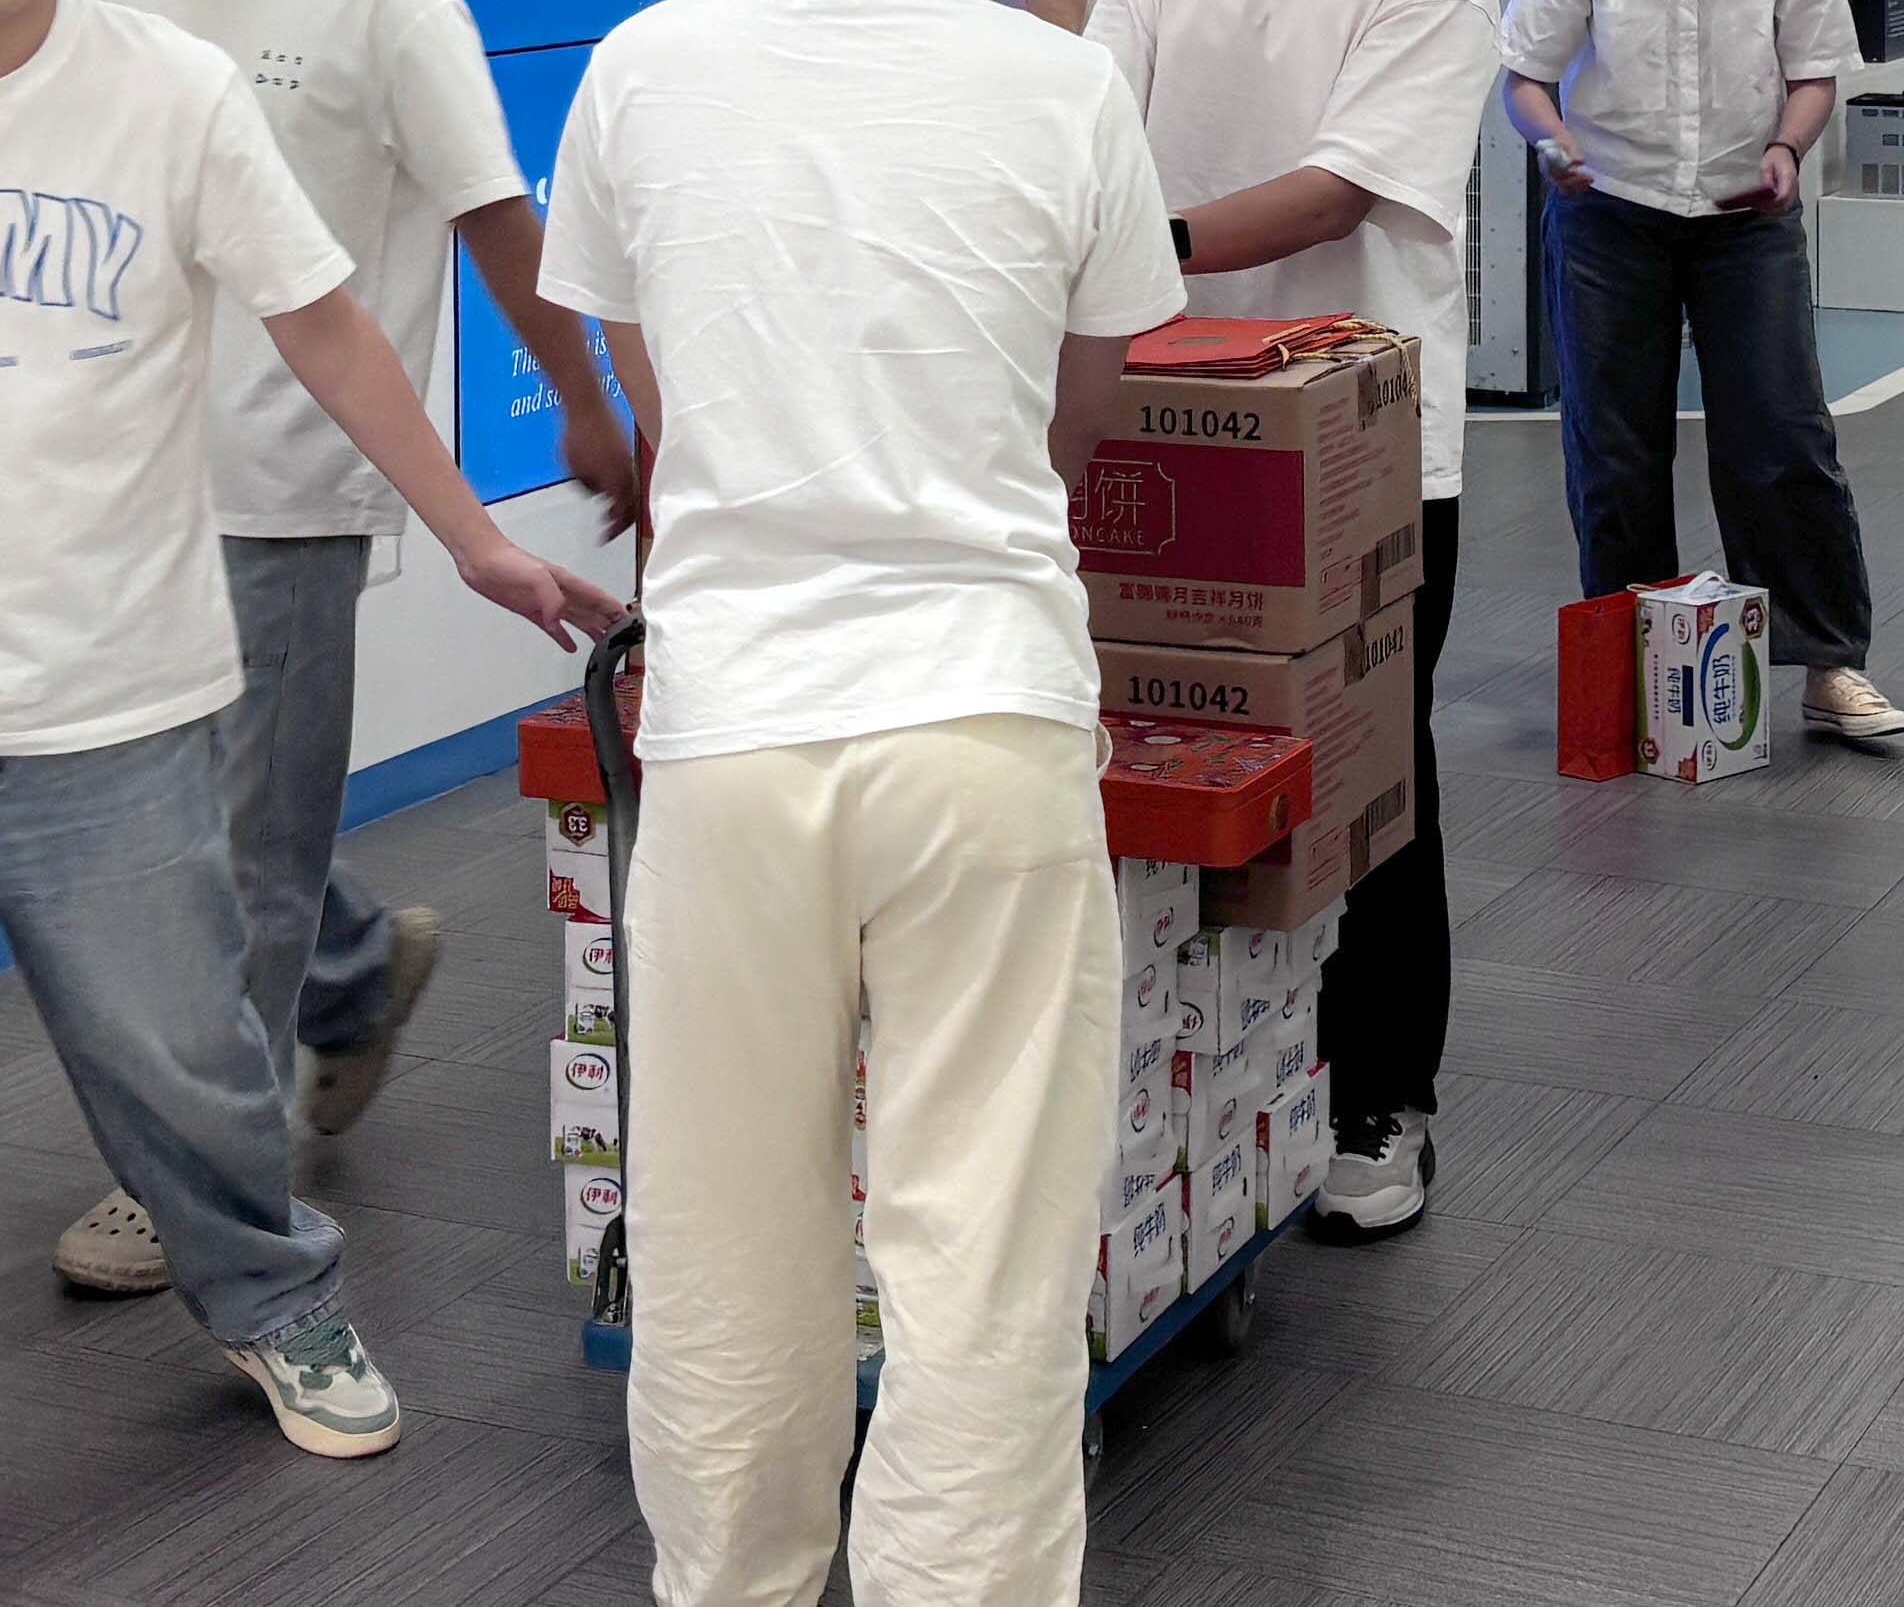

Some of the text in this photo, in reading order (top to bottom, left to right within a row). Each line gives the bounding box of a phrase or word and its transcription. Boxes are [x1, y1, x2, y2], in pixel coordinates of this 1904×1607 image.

[511, 393, 542, 419] and
[1139, 405, 1263, 442] 101042
[1127, 674, 1250, 715] 101042
[1712, 653, 1731, 724] 纯牛奶
[571, 1063, 605, 1080] 伊利
[1289, 1089, 1317, 1135] 纯牛奶
[1212, 1144, 1241, 1196] 纯牛奶
[586, 1187, 617, 1204] 伊利
[1133, 1201, 1166, 1257] 纯牛奶
